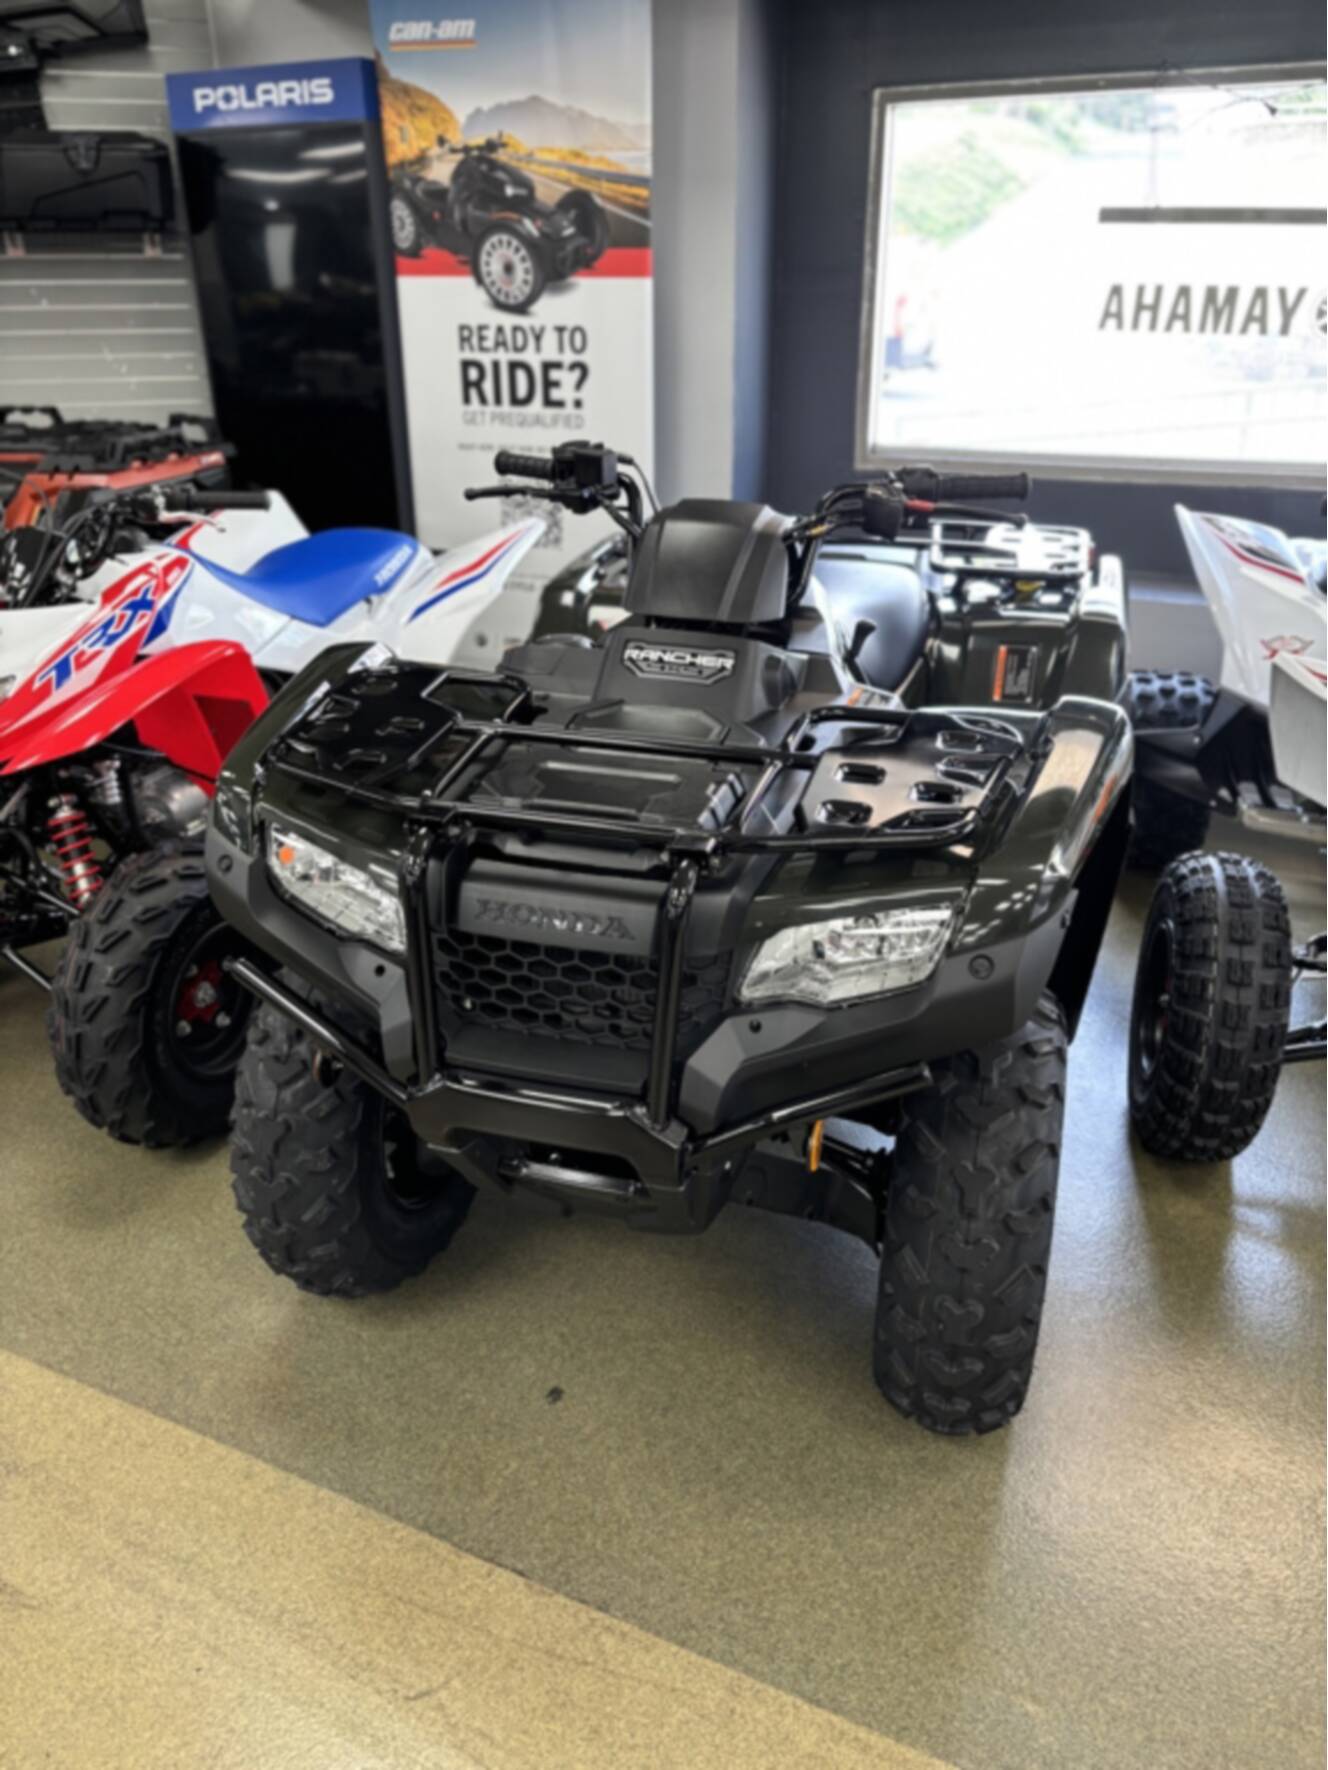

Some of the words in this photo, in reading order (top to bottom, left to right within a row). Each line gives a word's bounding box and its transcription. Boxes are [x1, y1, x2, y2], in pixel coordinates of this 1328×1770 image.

[389, 19, 476, 41] can-am
[193, 77, 335, 113] POLARIS
[457, 324, 545, 354] READY
[554, 325, 588, 355] TO
[460, 359, 590, 409] RIDE?
[462, 410, 486, 426] GET
[490, 411, 585, 429] PREQUALIFIED
[623, 648, 736, 669] RANCHER
[474, 897, 636, 941] HONDA
